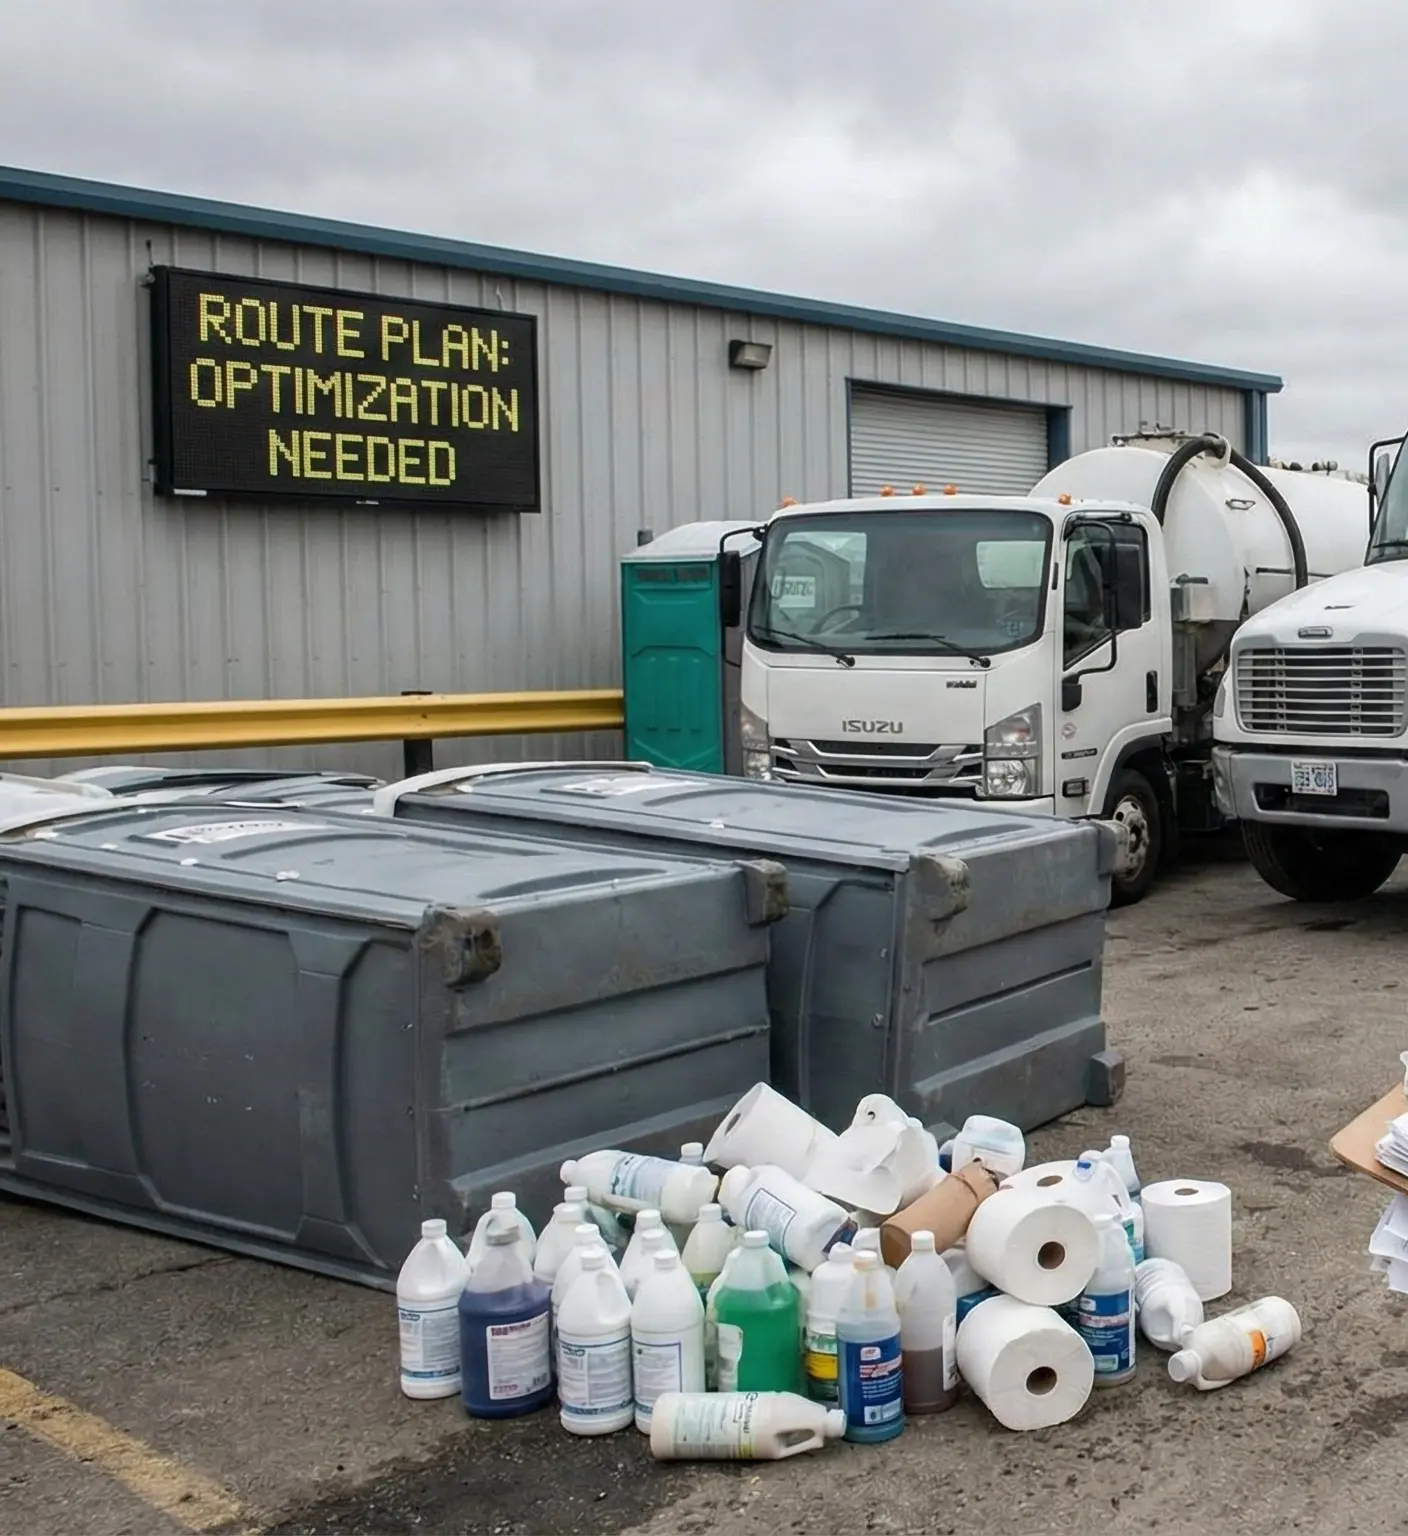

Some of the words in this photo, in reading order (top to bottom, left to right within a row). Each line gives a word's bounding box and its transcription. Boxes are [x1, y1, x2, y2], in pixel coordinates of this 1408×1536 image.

[199, 293, 365, 359] ROUTE
[381, 315, 510, 372] PLAN:
[190, 357, 519, 432] OPTIMIZATION
[268, 428, 457, 486] NEEDED
[842, 719, 904, 734] ISUZU
